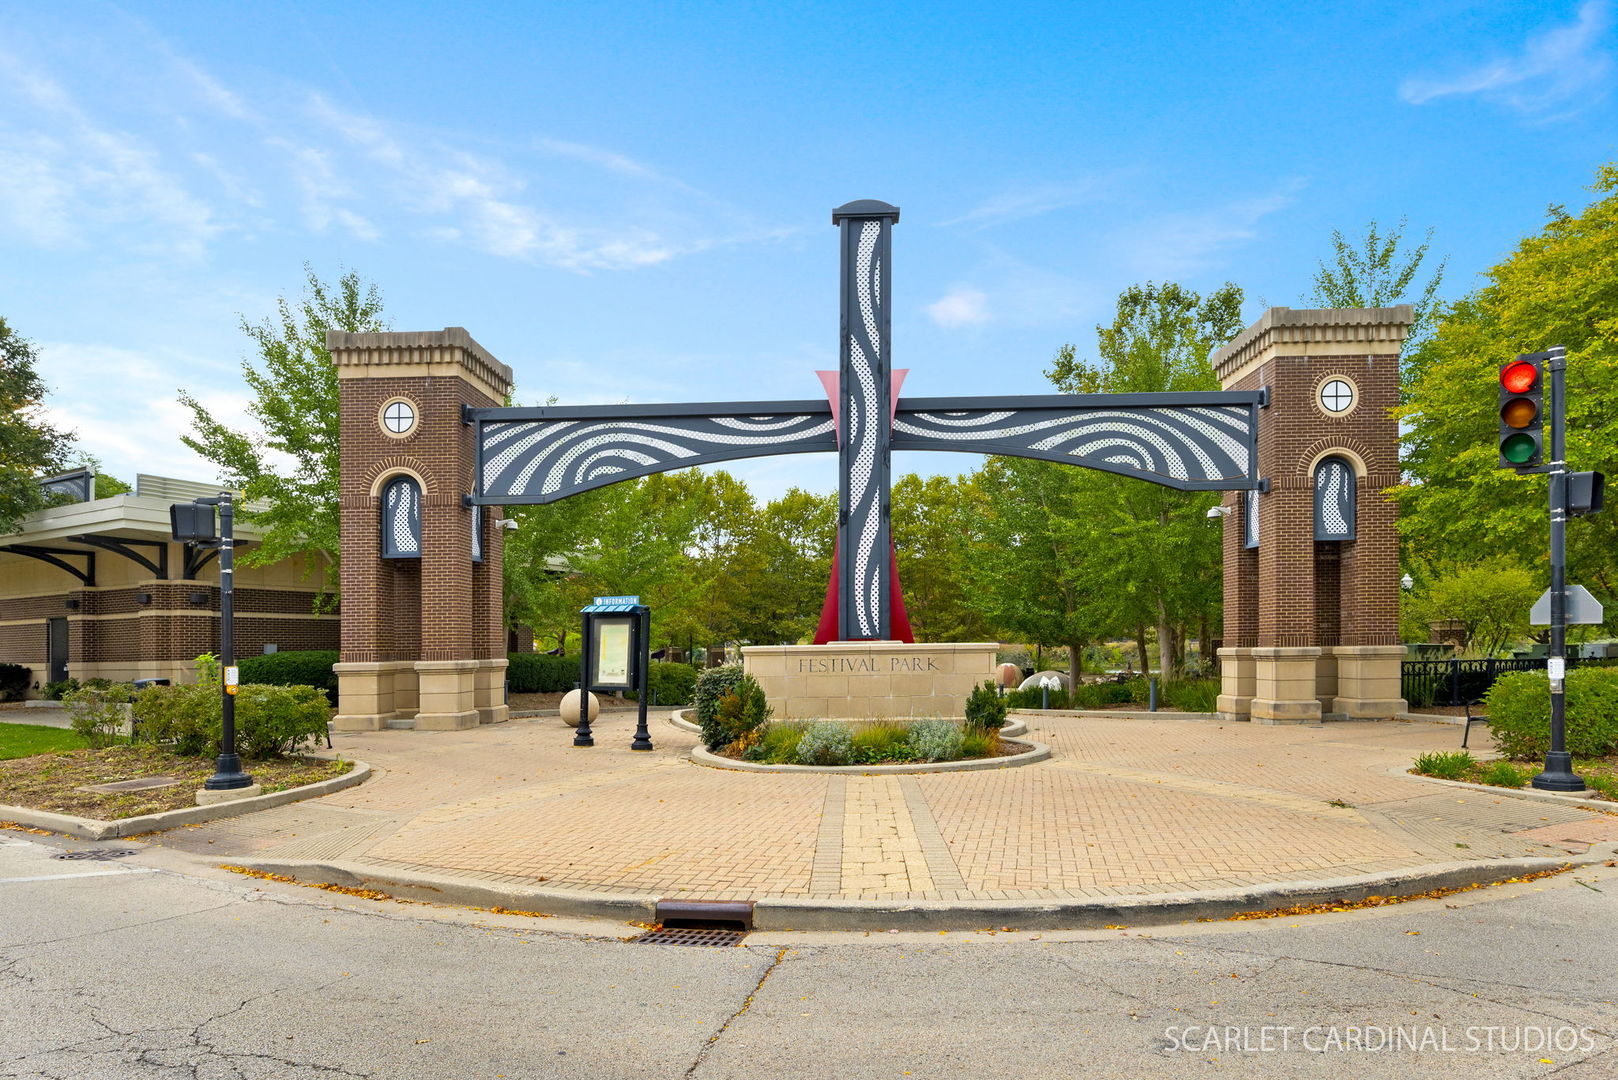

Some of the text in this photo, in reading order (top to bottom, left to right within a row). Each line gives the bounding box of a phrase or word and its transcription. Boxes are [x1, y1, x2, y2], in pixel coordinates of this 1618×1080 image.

[603, 597, 637, 605] INFORMATION
[799, 657, 941, 673] FESTIVAL PARK
